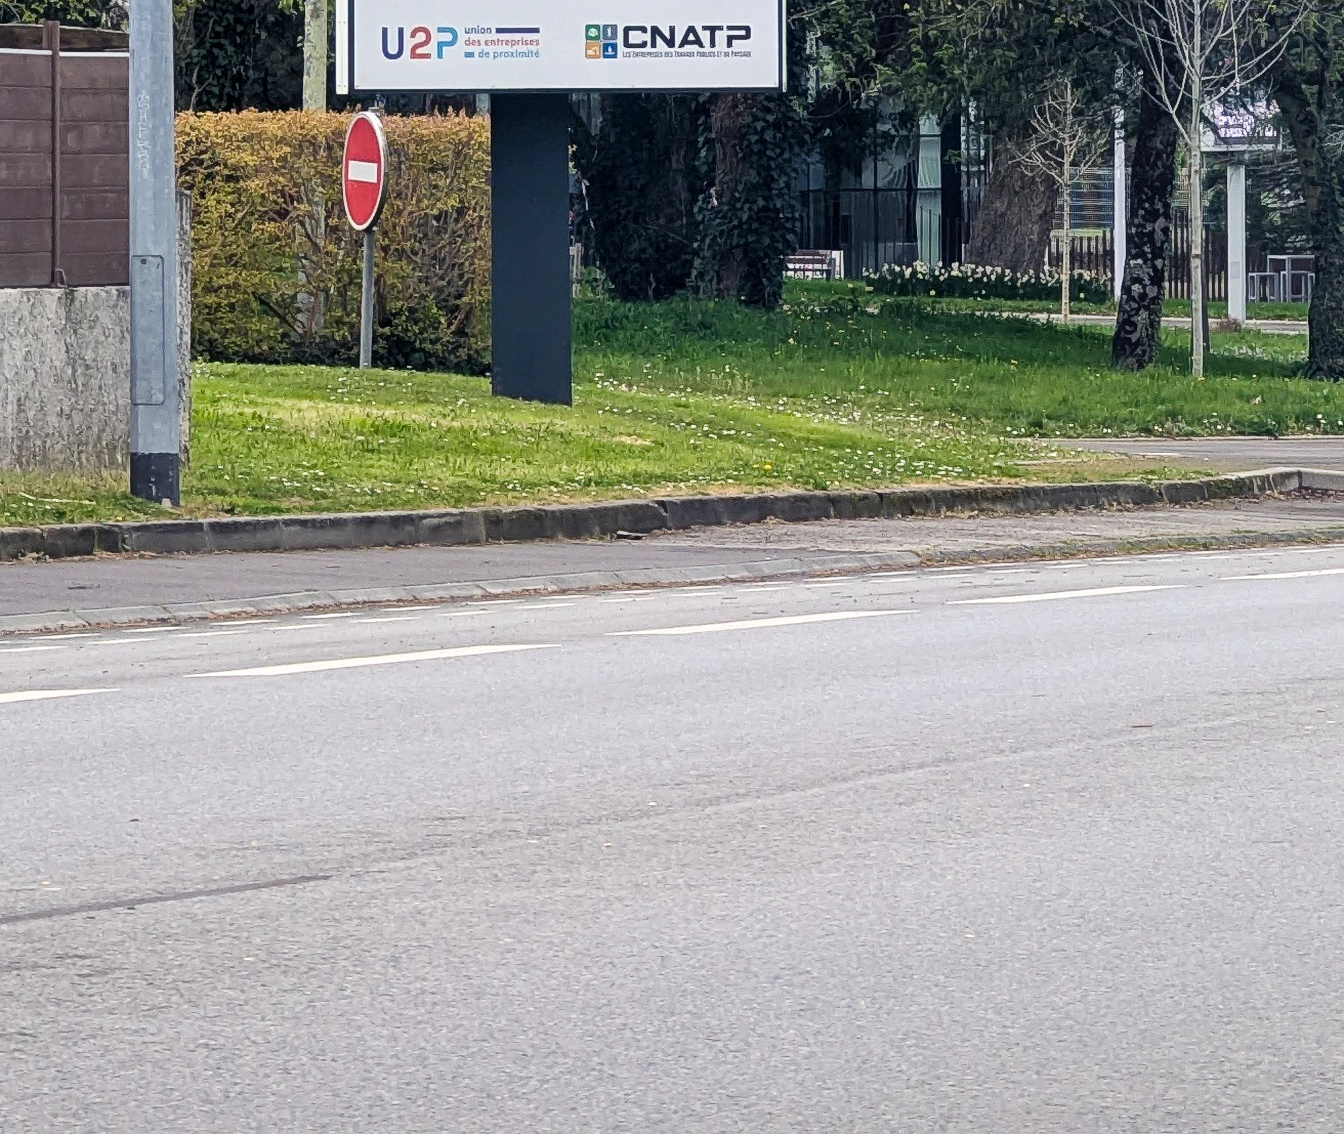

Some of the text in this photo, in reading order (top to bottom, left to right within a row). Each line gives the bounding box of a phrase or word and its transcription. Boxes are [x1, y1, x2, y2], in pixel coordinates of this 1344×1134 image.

[464, 25, 492, 34] union
[381, 26, 459, 60] U2P
[464, 37, 540, 48] des entreprises
[623, 25, 752, 48] CNATP
[478, 47, 540, 60] de proximité
